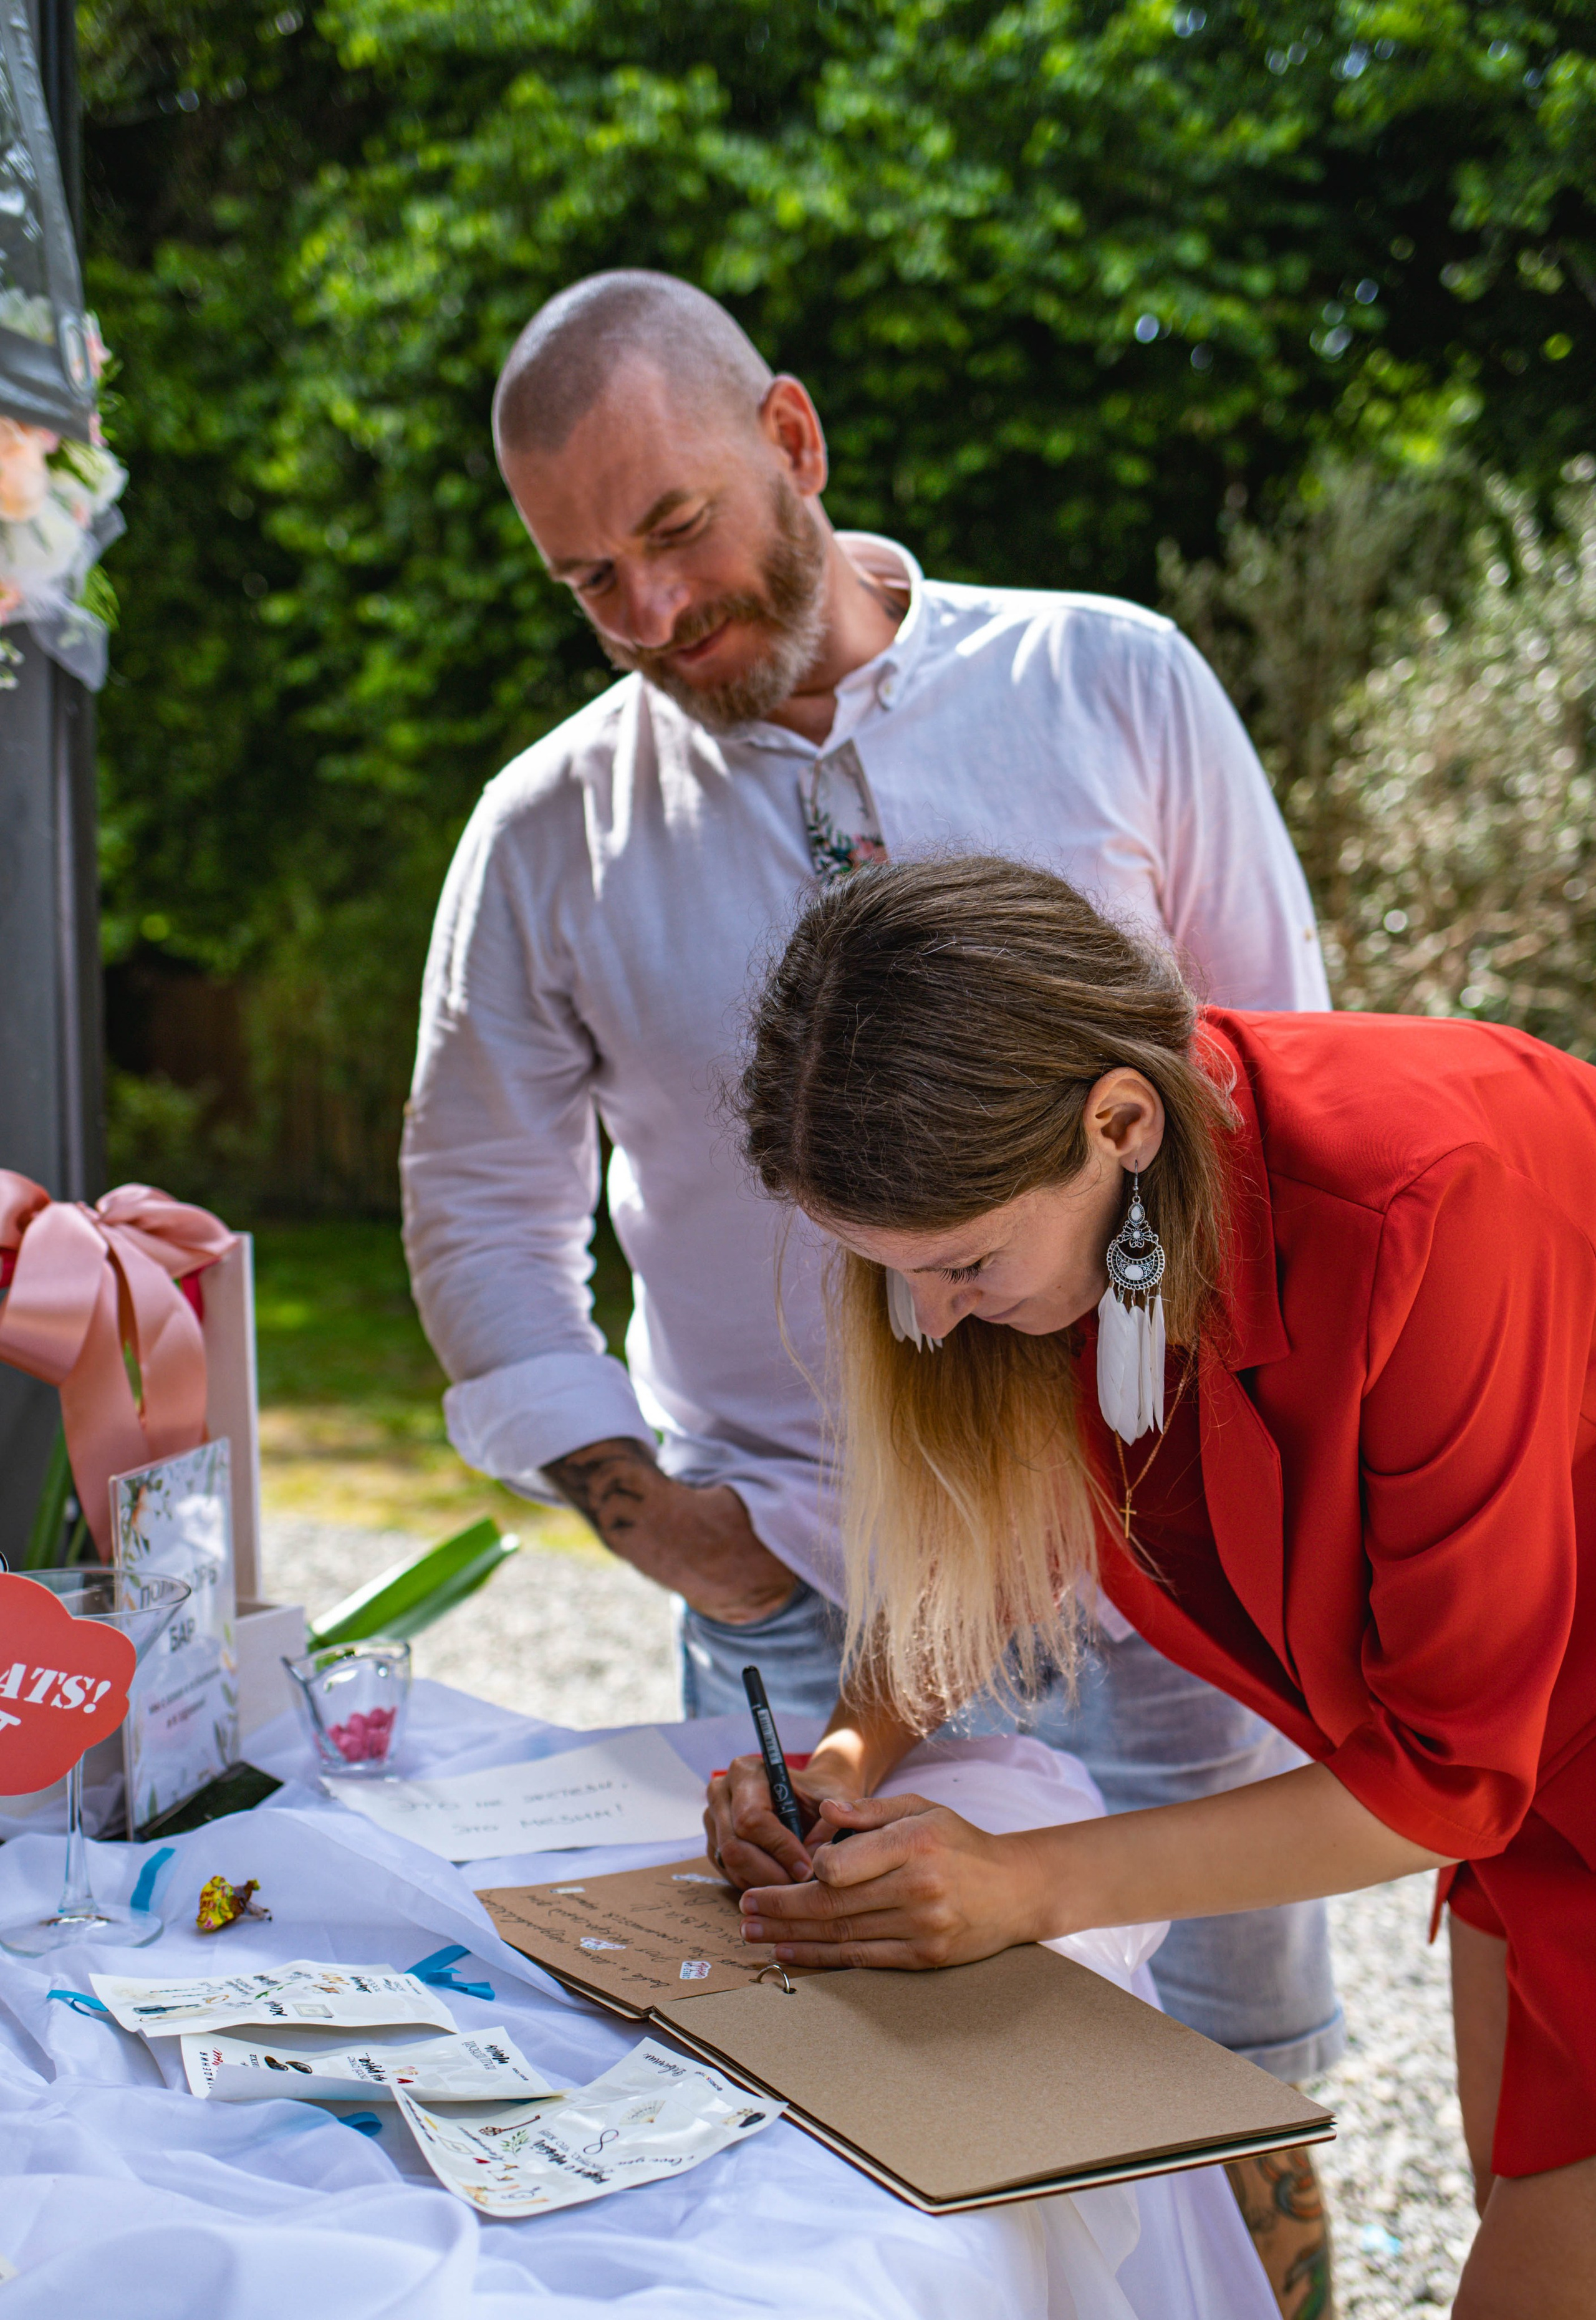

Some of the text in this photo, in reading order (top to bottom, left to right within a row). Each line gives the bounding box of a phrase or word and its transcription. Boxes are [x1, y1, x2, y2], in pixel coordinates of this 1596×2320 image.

[170, 1618, 195, 1652] БАР
[622, 1972, 673, 1988] Вова
[643, 2053, 687, 2077] Девичник
[617, 2156, 646, 2166] you
[648, 2156, 683, 2167] love
